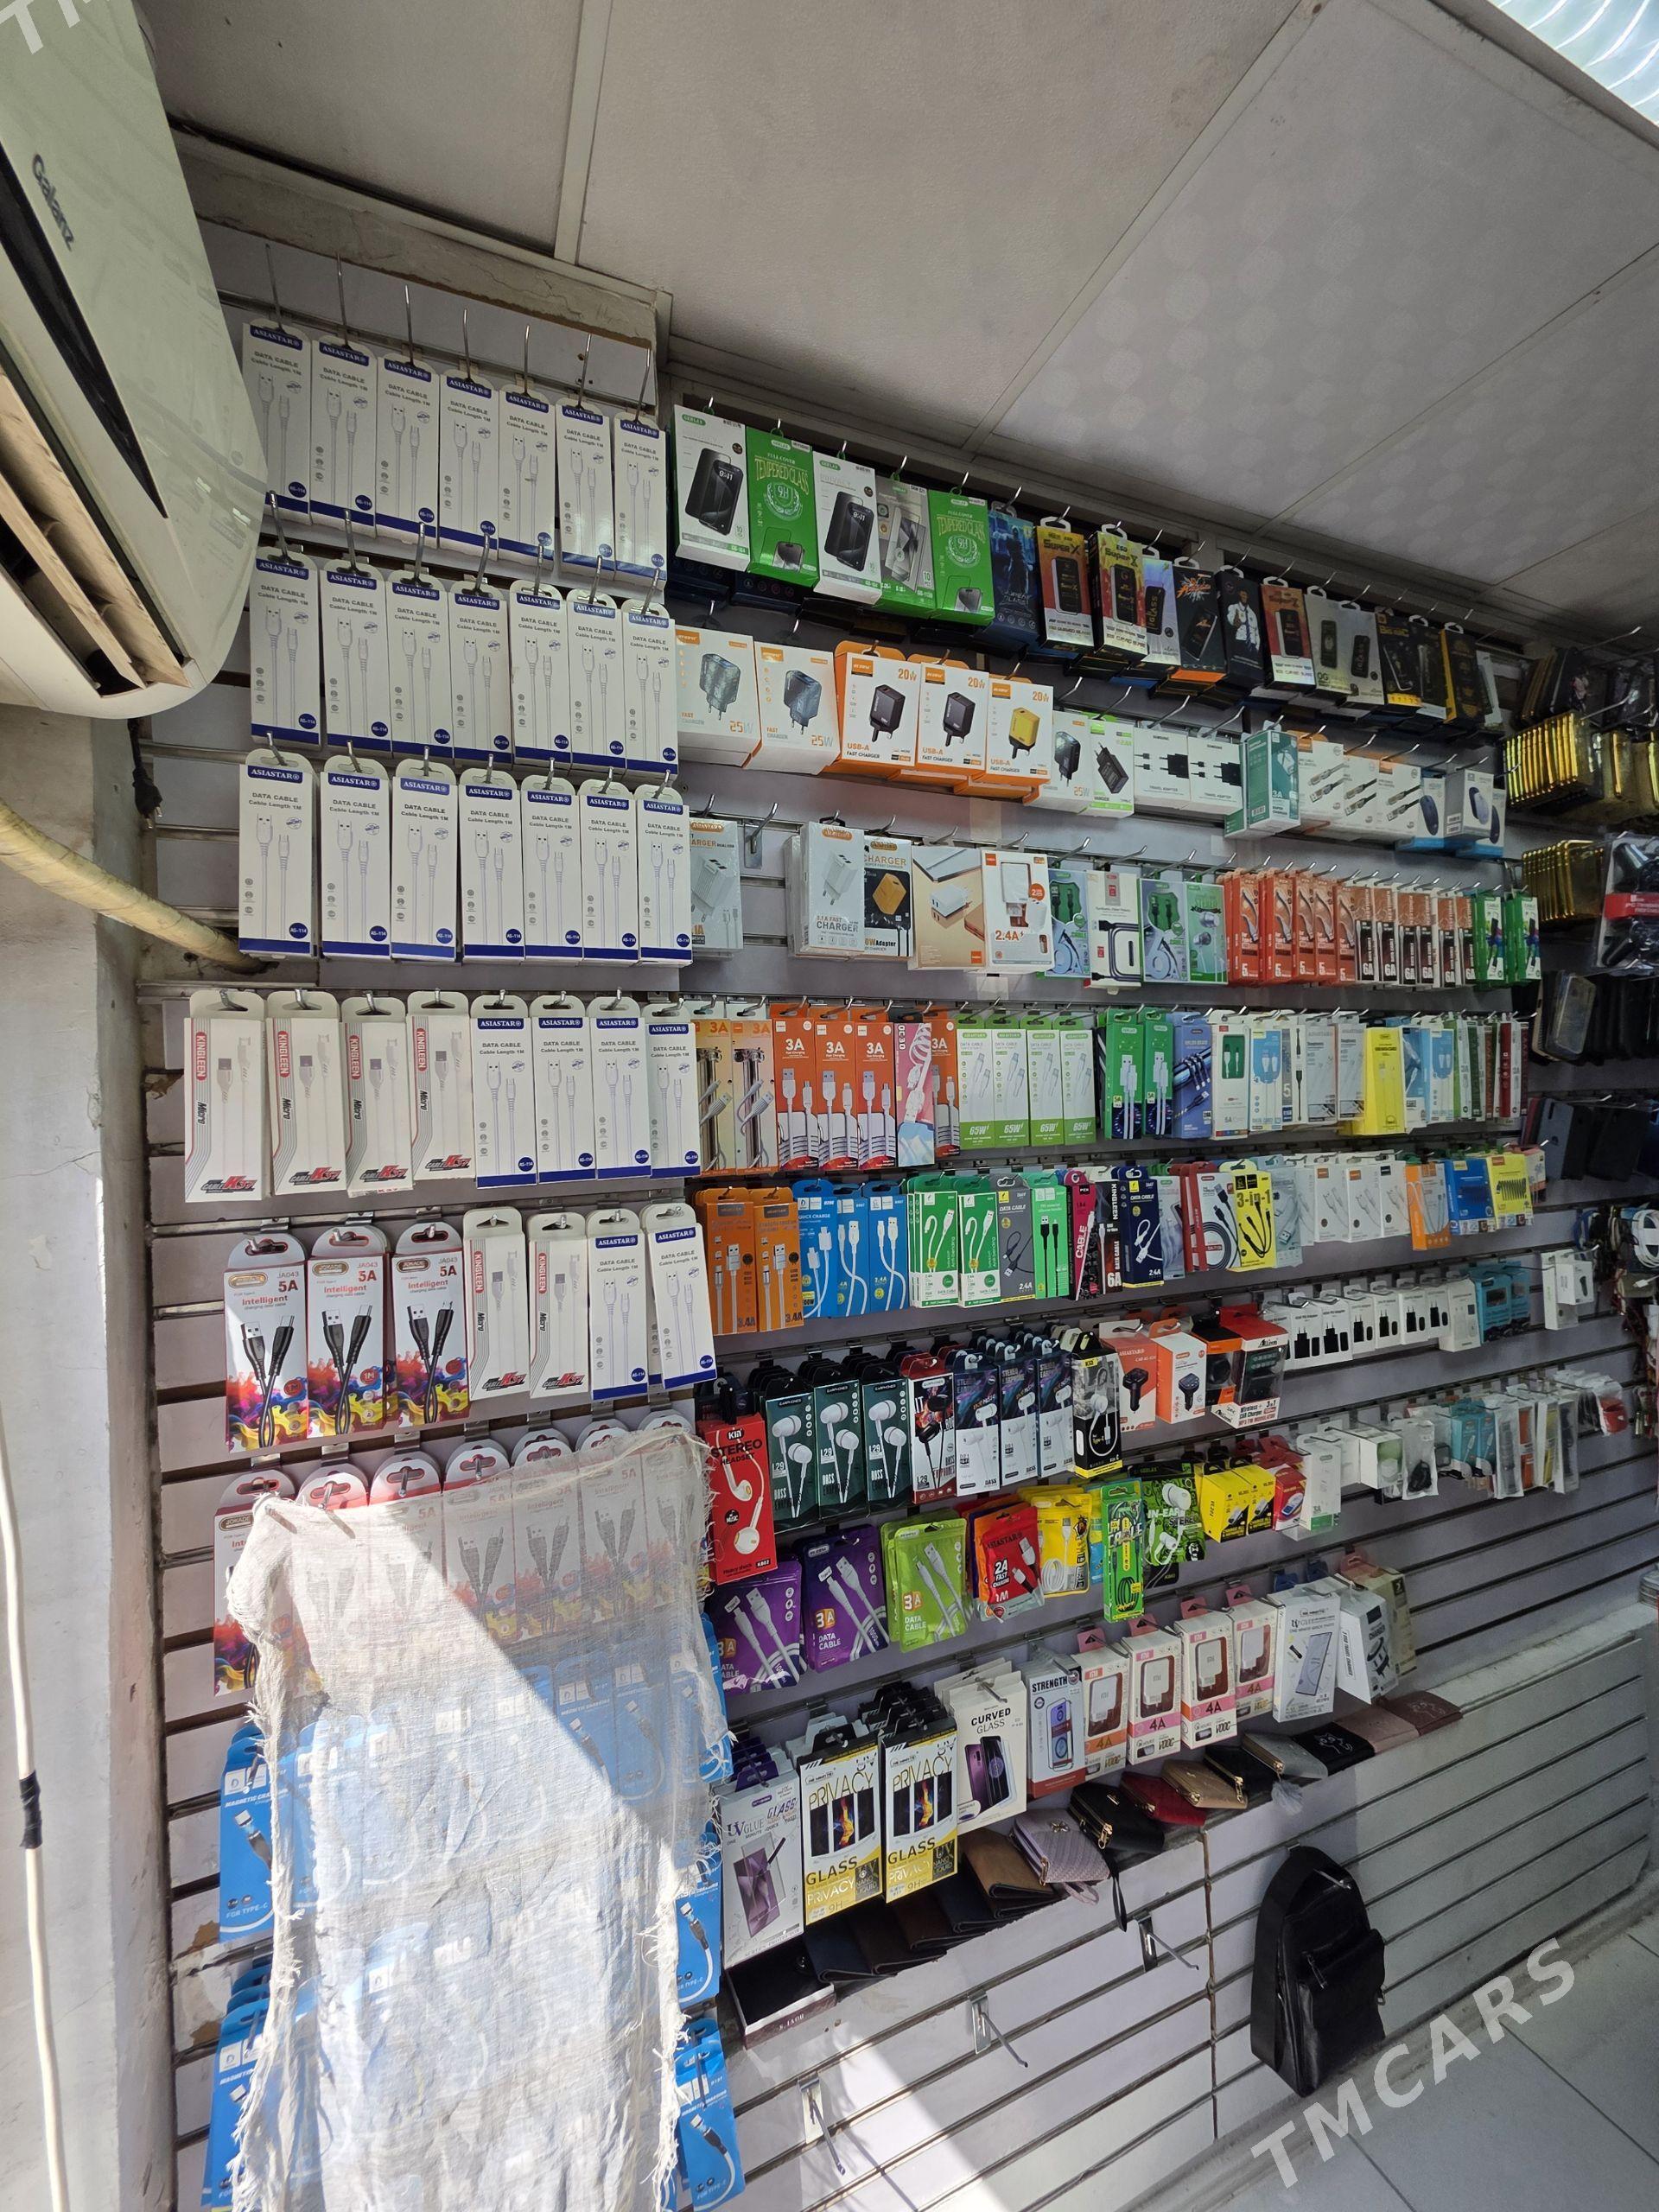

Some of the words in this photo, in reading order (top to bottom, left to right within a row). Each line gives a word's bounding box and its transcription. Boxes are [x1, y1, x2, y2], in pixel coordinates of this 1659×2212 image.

[323, 367, 340, 378] DATA
[343, 373, 365, 383] CABLE
[510, 416, 524, 424] DATA
[526, 420, 545, 429] CABLE
[261, 585, 279, 594] DATA
[281, 588, 305, 599] CABLE
[416, 610, 436, 619] CABLE
[811, 735, 834, 747] 25W
[848, 742, 870, 752] USB-A
[817, 921, 858, 932] CHARGER
[995, 931, 1019, 941] 2.4A
[710, 1022, 728, 1033] 3A
[753, 1023, 771, 1033] 3A
[417, 1031, 426, 1069] KINGLEEN
[785, 1038, 804, 1051] 3A
[826, 1040, 845, 1053] 3A
[867, 1042, 885, 1054] 3A
[931, 1038, 948, 1049] 3A
[197, 1035, 207, 1077] KINGLEEN
[279, 1034, 289, 1075] KINGLEEN
[350, 1039, 359, 1077] KINGLEEN
[419, 1090, 428, 1110] Micro
[197, 1102, 207, 1125] Micro
[282, 1097, 291, 1119] Micro
[353, 1099, 362, 1120] Micro
[969, 1126, 987, 1135] 65W
[1004, 1124, 1021, 1134] 65W
[1039, 1123, 1056, 1133] 65W
[1236, 1189, 1270, 1207] 3-in-1
[1076, 1226, 1088, 1258] CABLE
[358, 1270, 377, 1282] 5A
[439, 1265, 457, 1278] 5A
[278, 1279, 298, 1293] 5A
[408, 1280, 448, 1289] Intelligent
[1107, 1273, 1122, 1287] 6A
[324, 1285, 367, 1294] Intelligent
[242, 1295, 288, 1306] Intelligent
[477, 1312, 486, 1332] Micro
[995, 1560, 1008, 1574] 2A
[995, 1572, 1008, 1581] FAST
[905, 1622, 927, 1630] CABLE
[819, 1634, 836, 1643] DATA
[819, 1639, 841, 1649] CABLE
[1032, 1676, 1067, 1693] STRENGTH
[1247, 1682, 1262, 1694] 4A
[1205, 1700, 1223, 1713] 4A
[971, 1707, 1011, 1726] CURVED
[977, 1719, 1005, 1734] GLASS
[1149, 1718, 1166, 1730] 4A
[1096, 1738, 1113, 1749] 4A
[893, 1756, 952, 1791] PRIVACY
[809, 1770, 874, 1811] PRIVACY
[744, 1820, 764, 1834] GLUE
[888, 1837, 936, 1865] GLASS
[805, 1856, 858, 1885] GLASS
[807, 1878, 855, 1906] PRIVACY
[242, 1904, 268, 1915] TYPE-C
